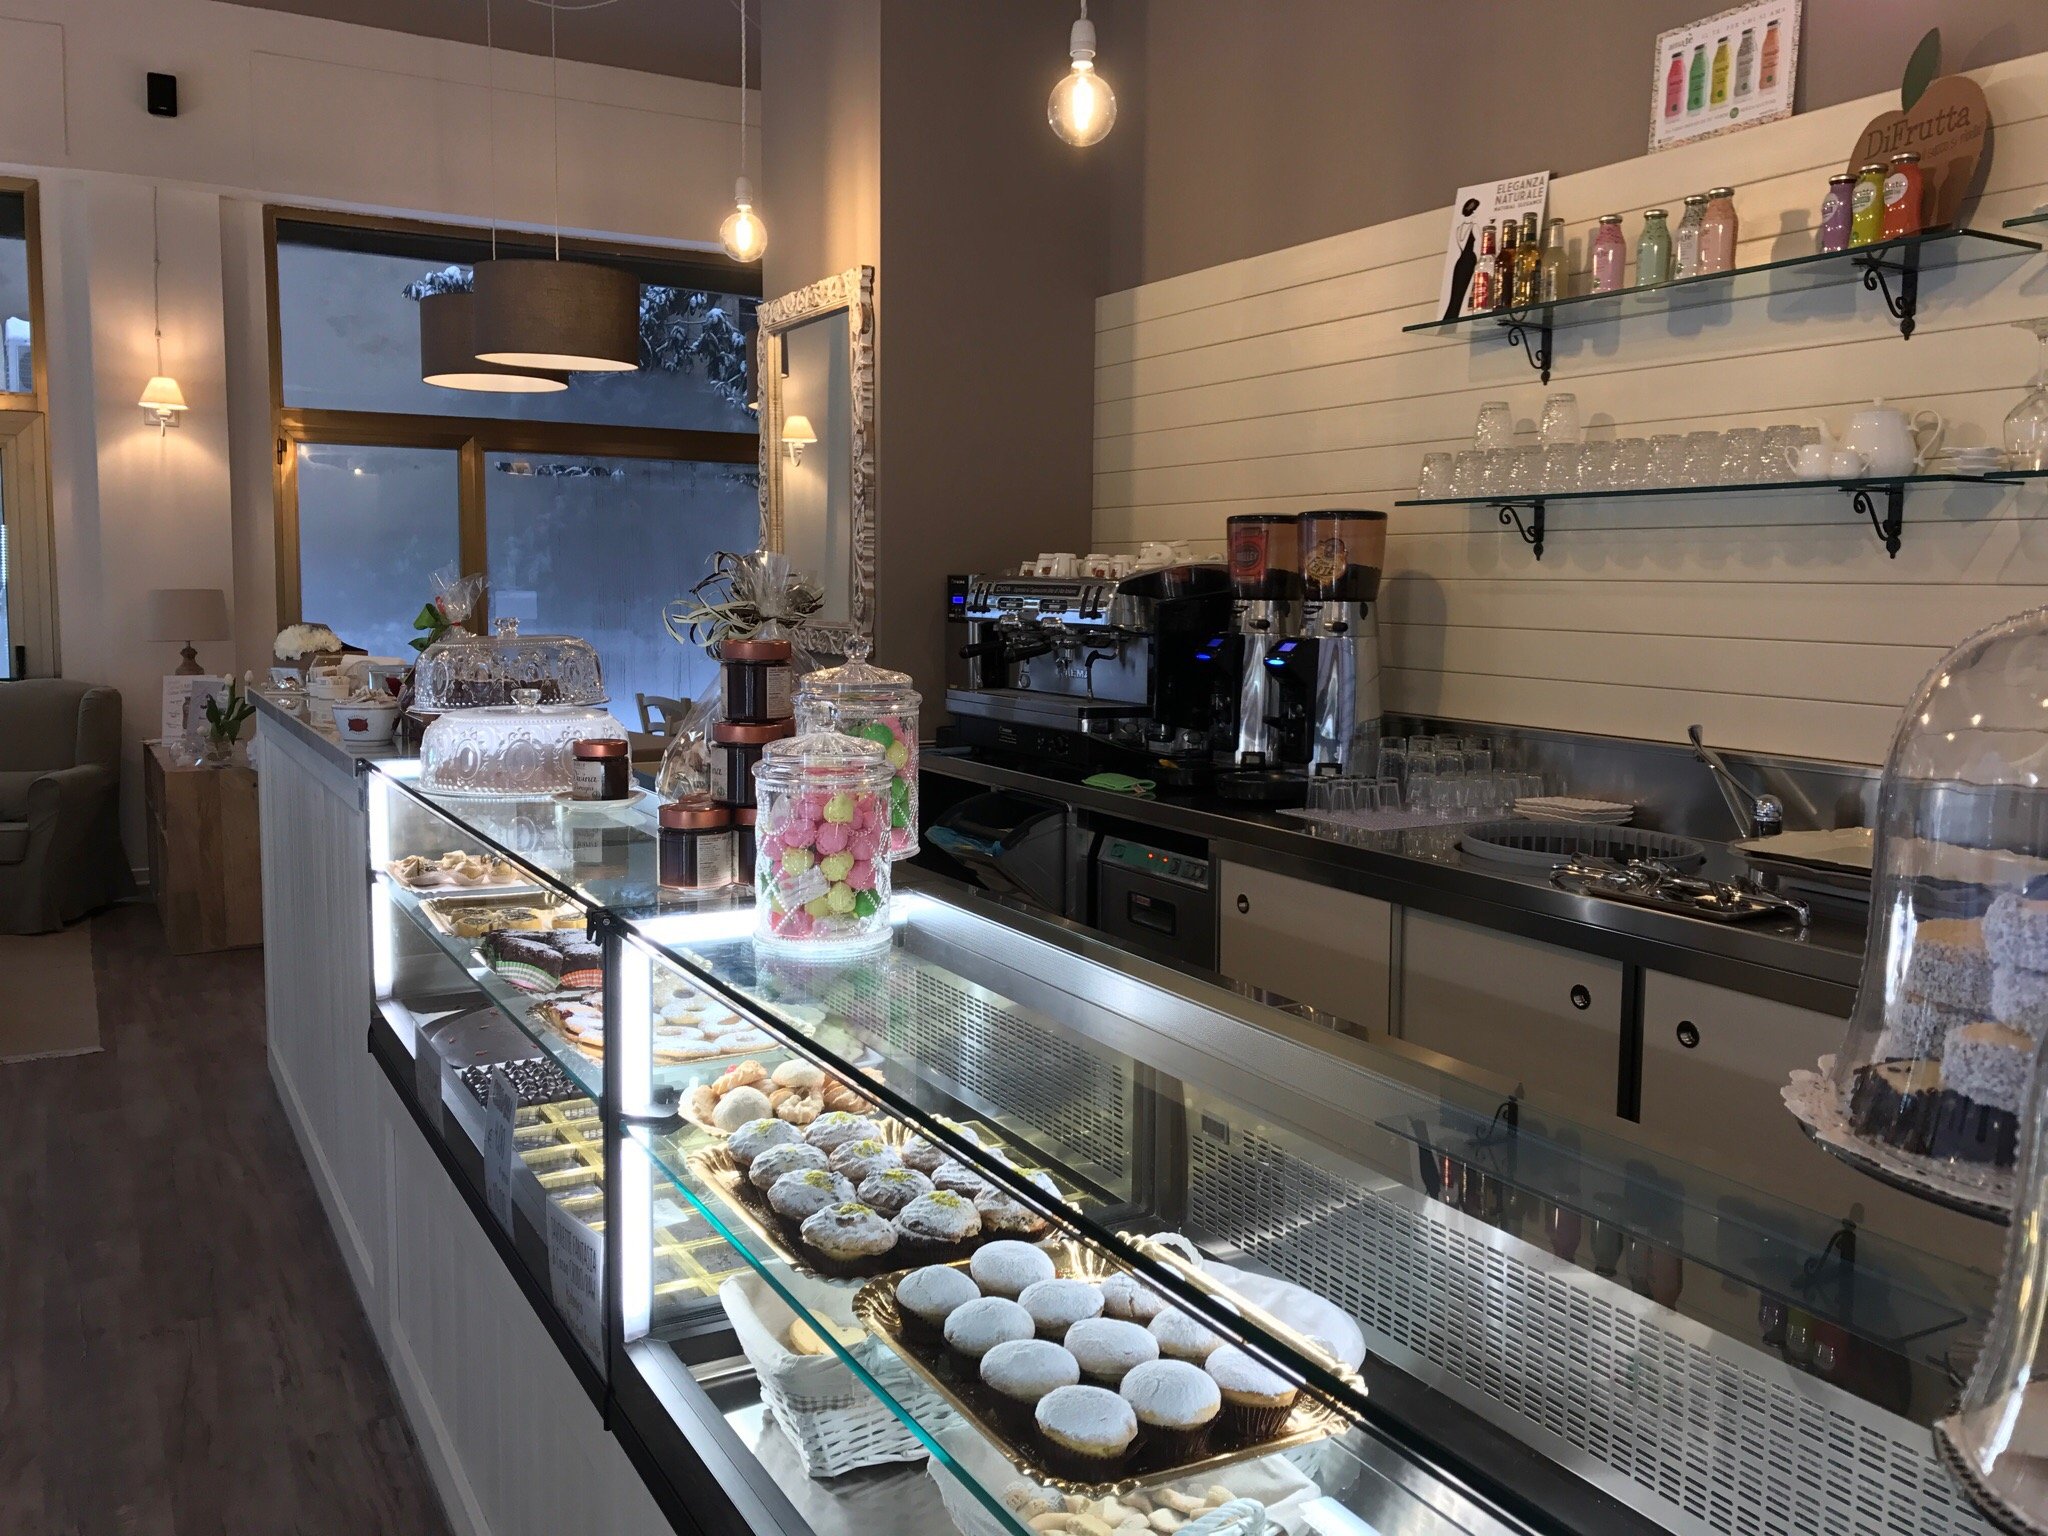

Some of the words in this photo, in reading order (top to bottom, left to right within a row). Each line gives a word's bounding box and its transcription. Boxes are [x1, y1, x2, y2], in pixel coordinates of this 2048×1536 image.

[1863, 105, 1971, 160] DiFrutta
[1496, 175, 1545, 195] ELEGANZA
[1494, 186, 1544, 206] NATURALE
